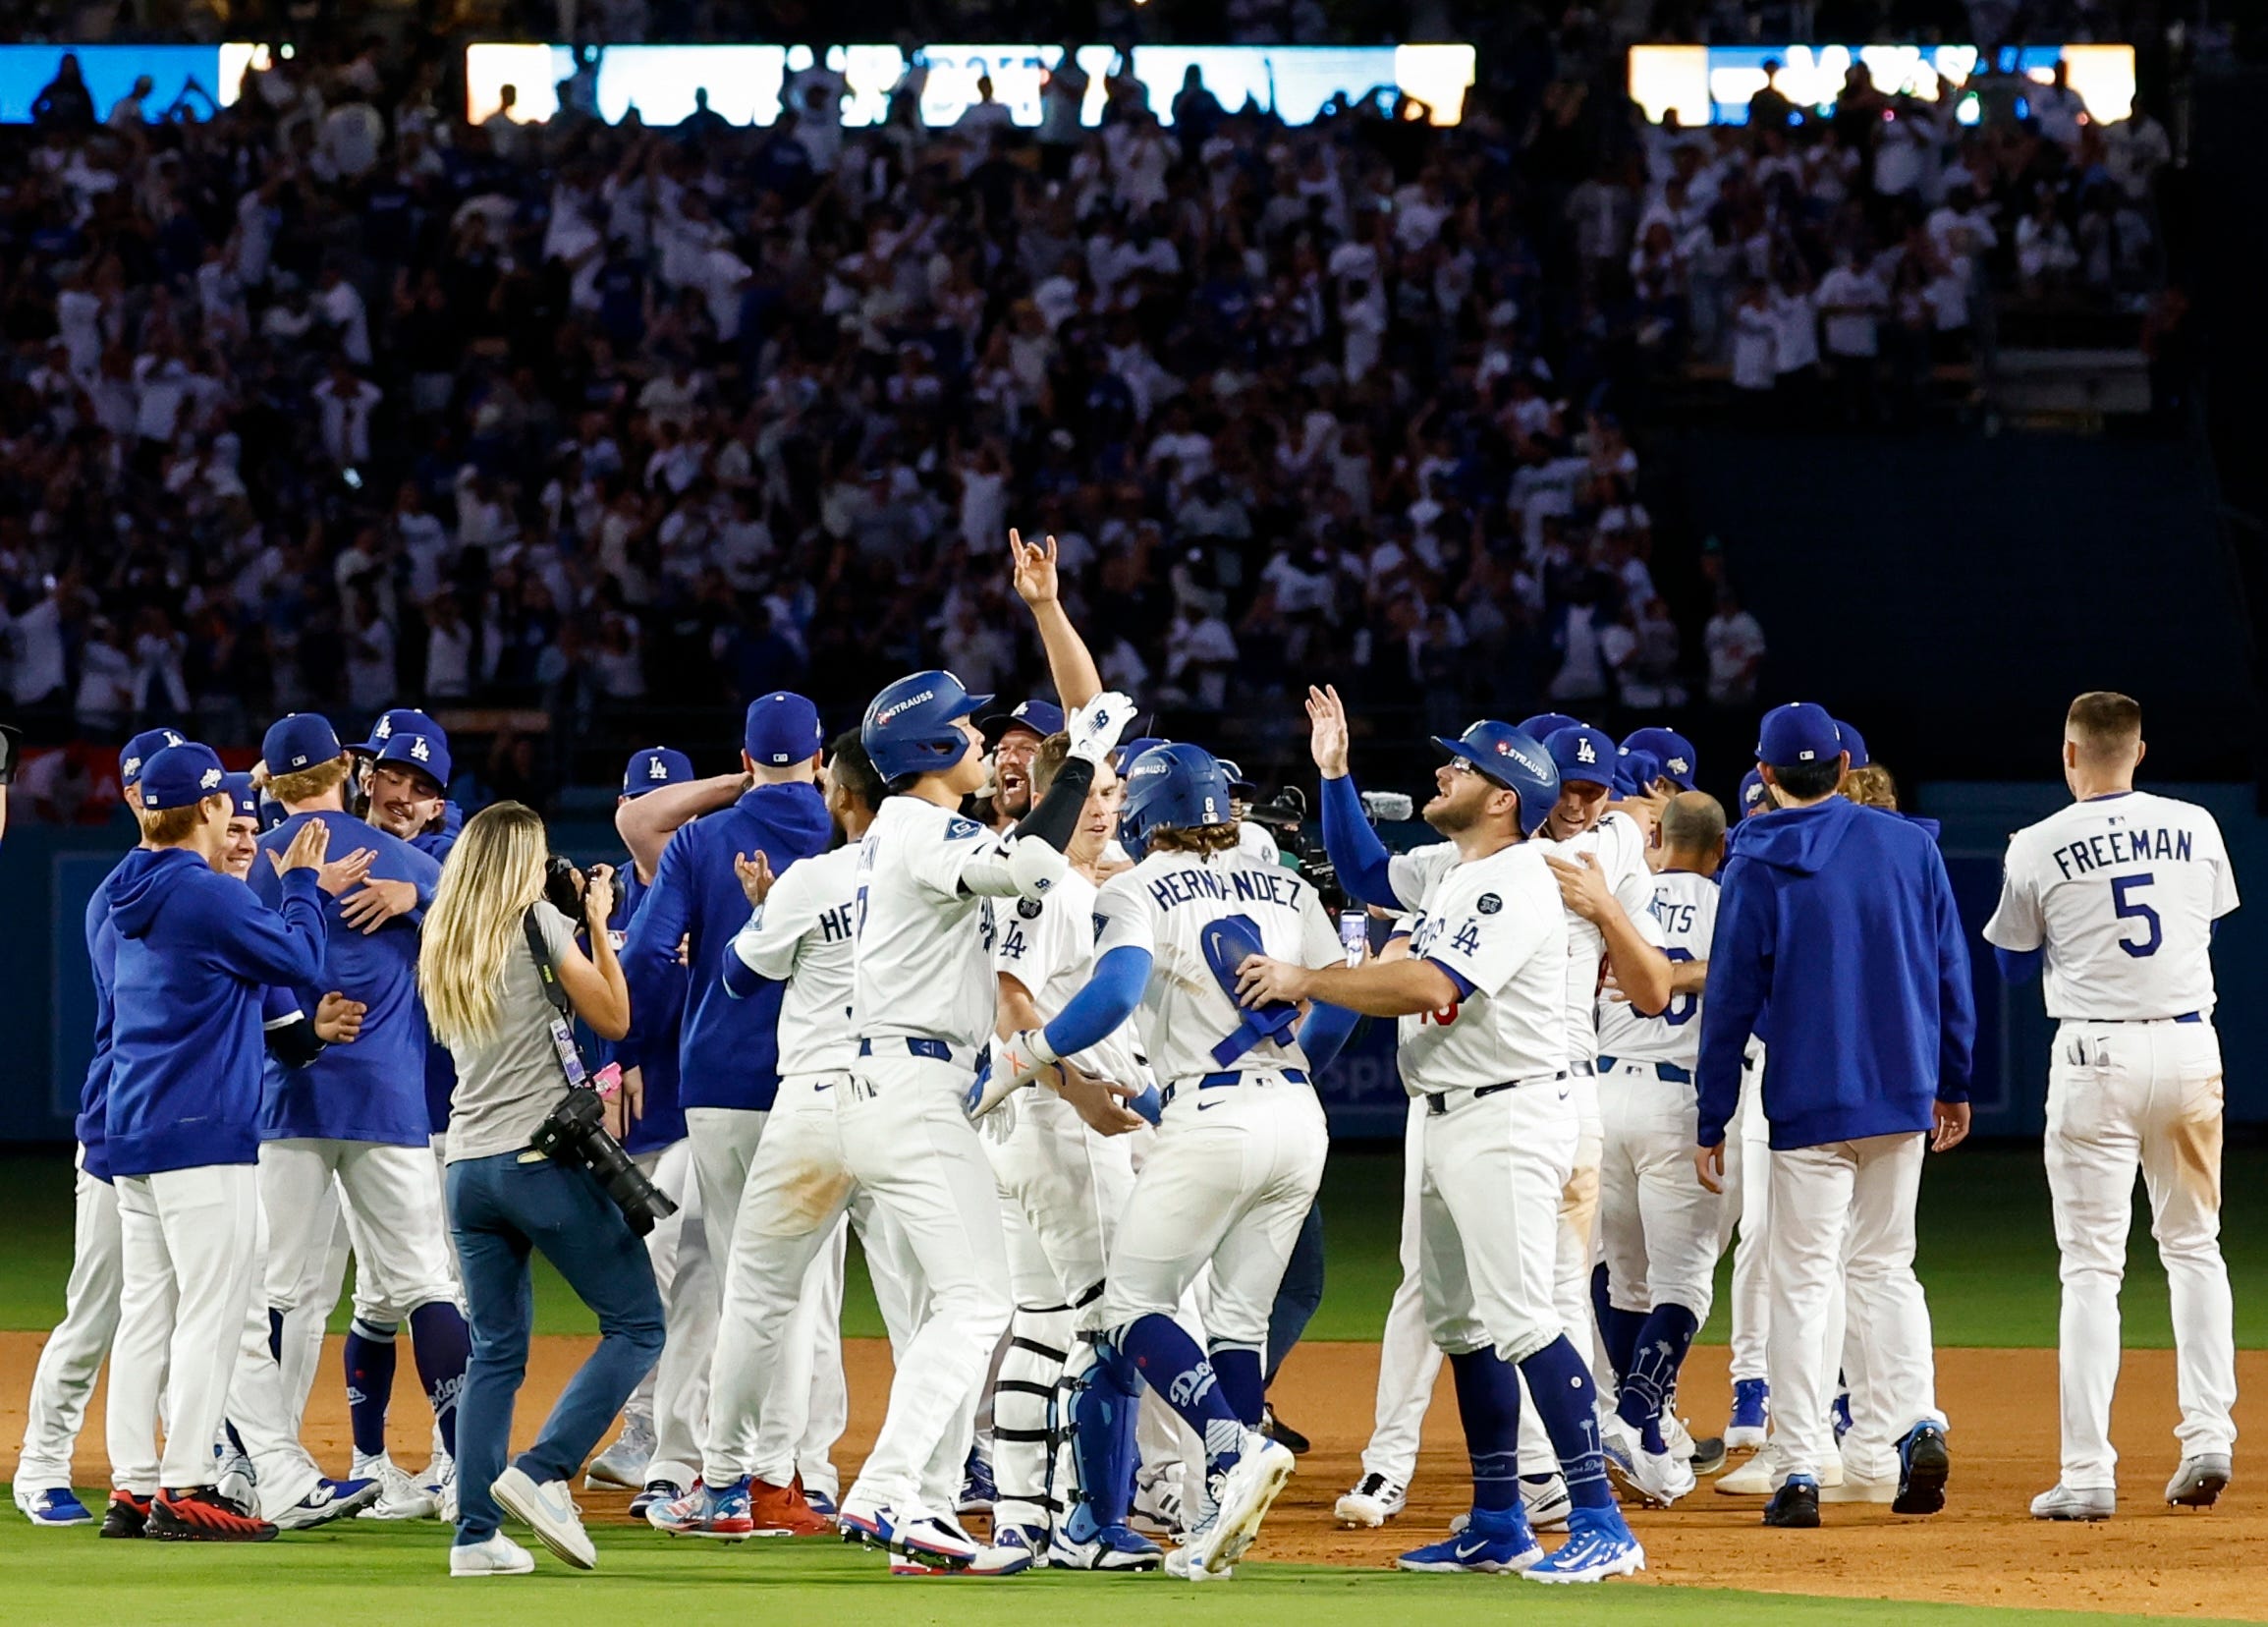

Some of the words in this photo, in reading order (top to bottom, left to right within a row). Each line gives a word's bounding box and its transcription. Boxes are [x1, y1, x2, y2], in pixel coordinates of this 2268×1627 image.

[888, 690, 934, 717] STRAUSS
[411, 736, 429, 762] LA
[1507, 748, 1548, 781] STRAUSS
[1577, 738, 1596, 763] LA
[649, 756, 667, 779] LA
[1205, 797, 1214, 813] 8
[2053, 828, 2191, 880] FREEMAN
[819, 902, 853, 942] HE
[2111, 872, 2162, 959] 5
[1000, 920, 1027, 960] LA
[1451, 917, 1480, 958] LA
